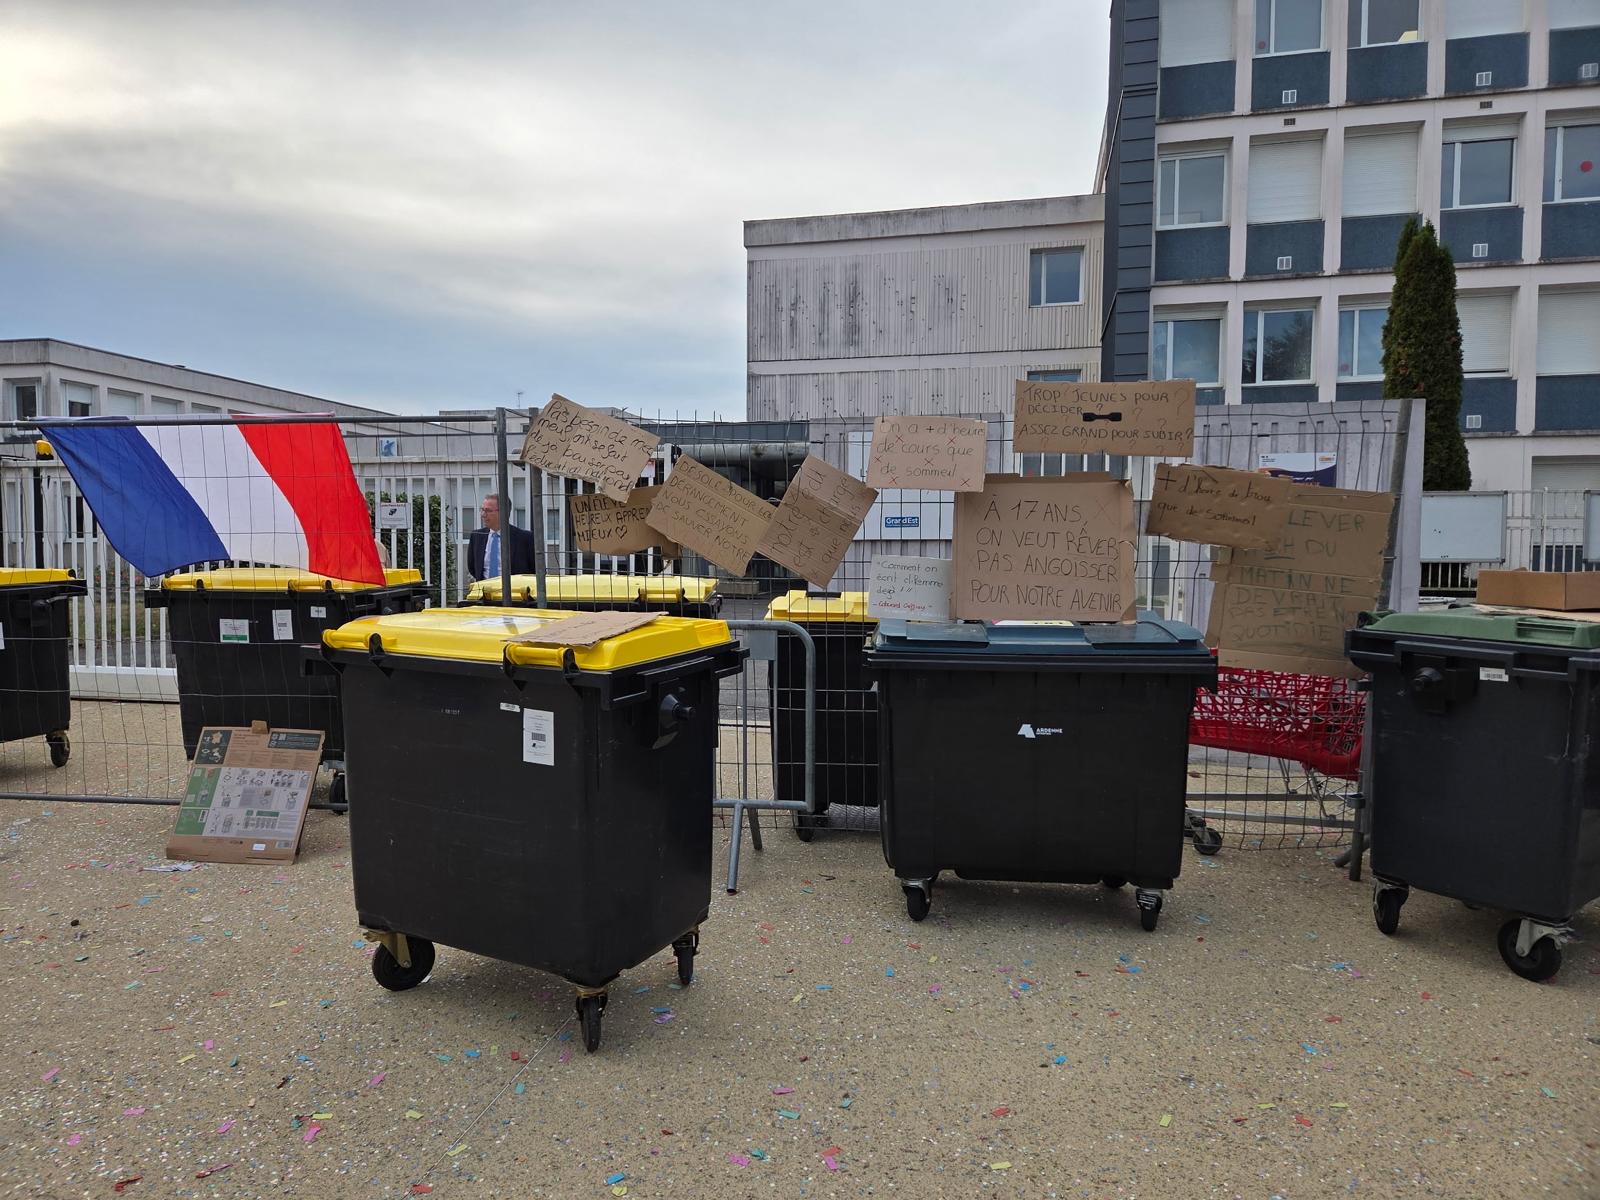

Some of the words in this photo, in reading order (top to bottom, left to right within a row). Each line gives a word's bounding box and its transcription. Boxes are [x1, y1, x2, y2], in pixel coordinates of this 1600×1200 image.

[1023, 384, 1060, 403] TROP
[1072, 388, 1128, 403] JEUNES
[1134, 391, 1169, 405] POUR
[880, 421, 900, 433] On
[908, 423, 919, 434] a
[925, 425, 935, 433] +
[1019, 424, 1059, 436] ASSEZ
[1062, 425, 1108, 439] GRAND
[1111, 429, 1139, 440] POUR
[876, 437, 896, 454] de
[901, 444, 940, 455] cours
[947, 445, 975, 462] que
[880, 462, 897, 474] de
[906, 463, 957, 478] sommeil
[1156, 470, 1177, 491] +
[575, 501, 591, 513] UN
[662, 490, 690, 510] NOUS
[728, 488, 757, 509] POUR
[984, 494, 1001, 521] À
[1008, 499, 1040, 521] 17
[1157, 502, 1180, 520] que
[1288, 510, 1365, 533] LEVER
[577, 528, 613, 541] MIEUX
[671, 512, 713, 537] SAUVER
[714, 535, 752, 564] NOTRE
[976, 527, 1003, 547] ON
[1012, 529, 1060, 550] VEUT
[1305, 539, 1337, 557] DU
[924, 565, 938, 573] on
[976, 549, 1013, 573] PAS
[1023, 553, 1119, 584] ANGOISSER
[1241, 566, 1312, 590] MATIN
[1325, 575, 1357, 594] NE
[970, 579, 1010, 605] POUR
[1016, 584, 1064, 608] NOTRE
[1070, 588, 1122, 613] AVENIR
